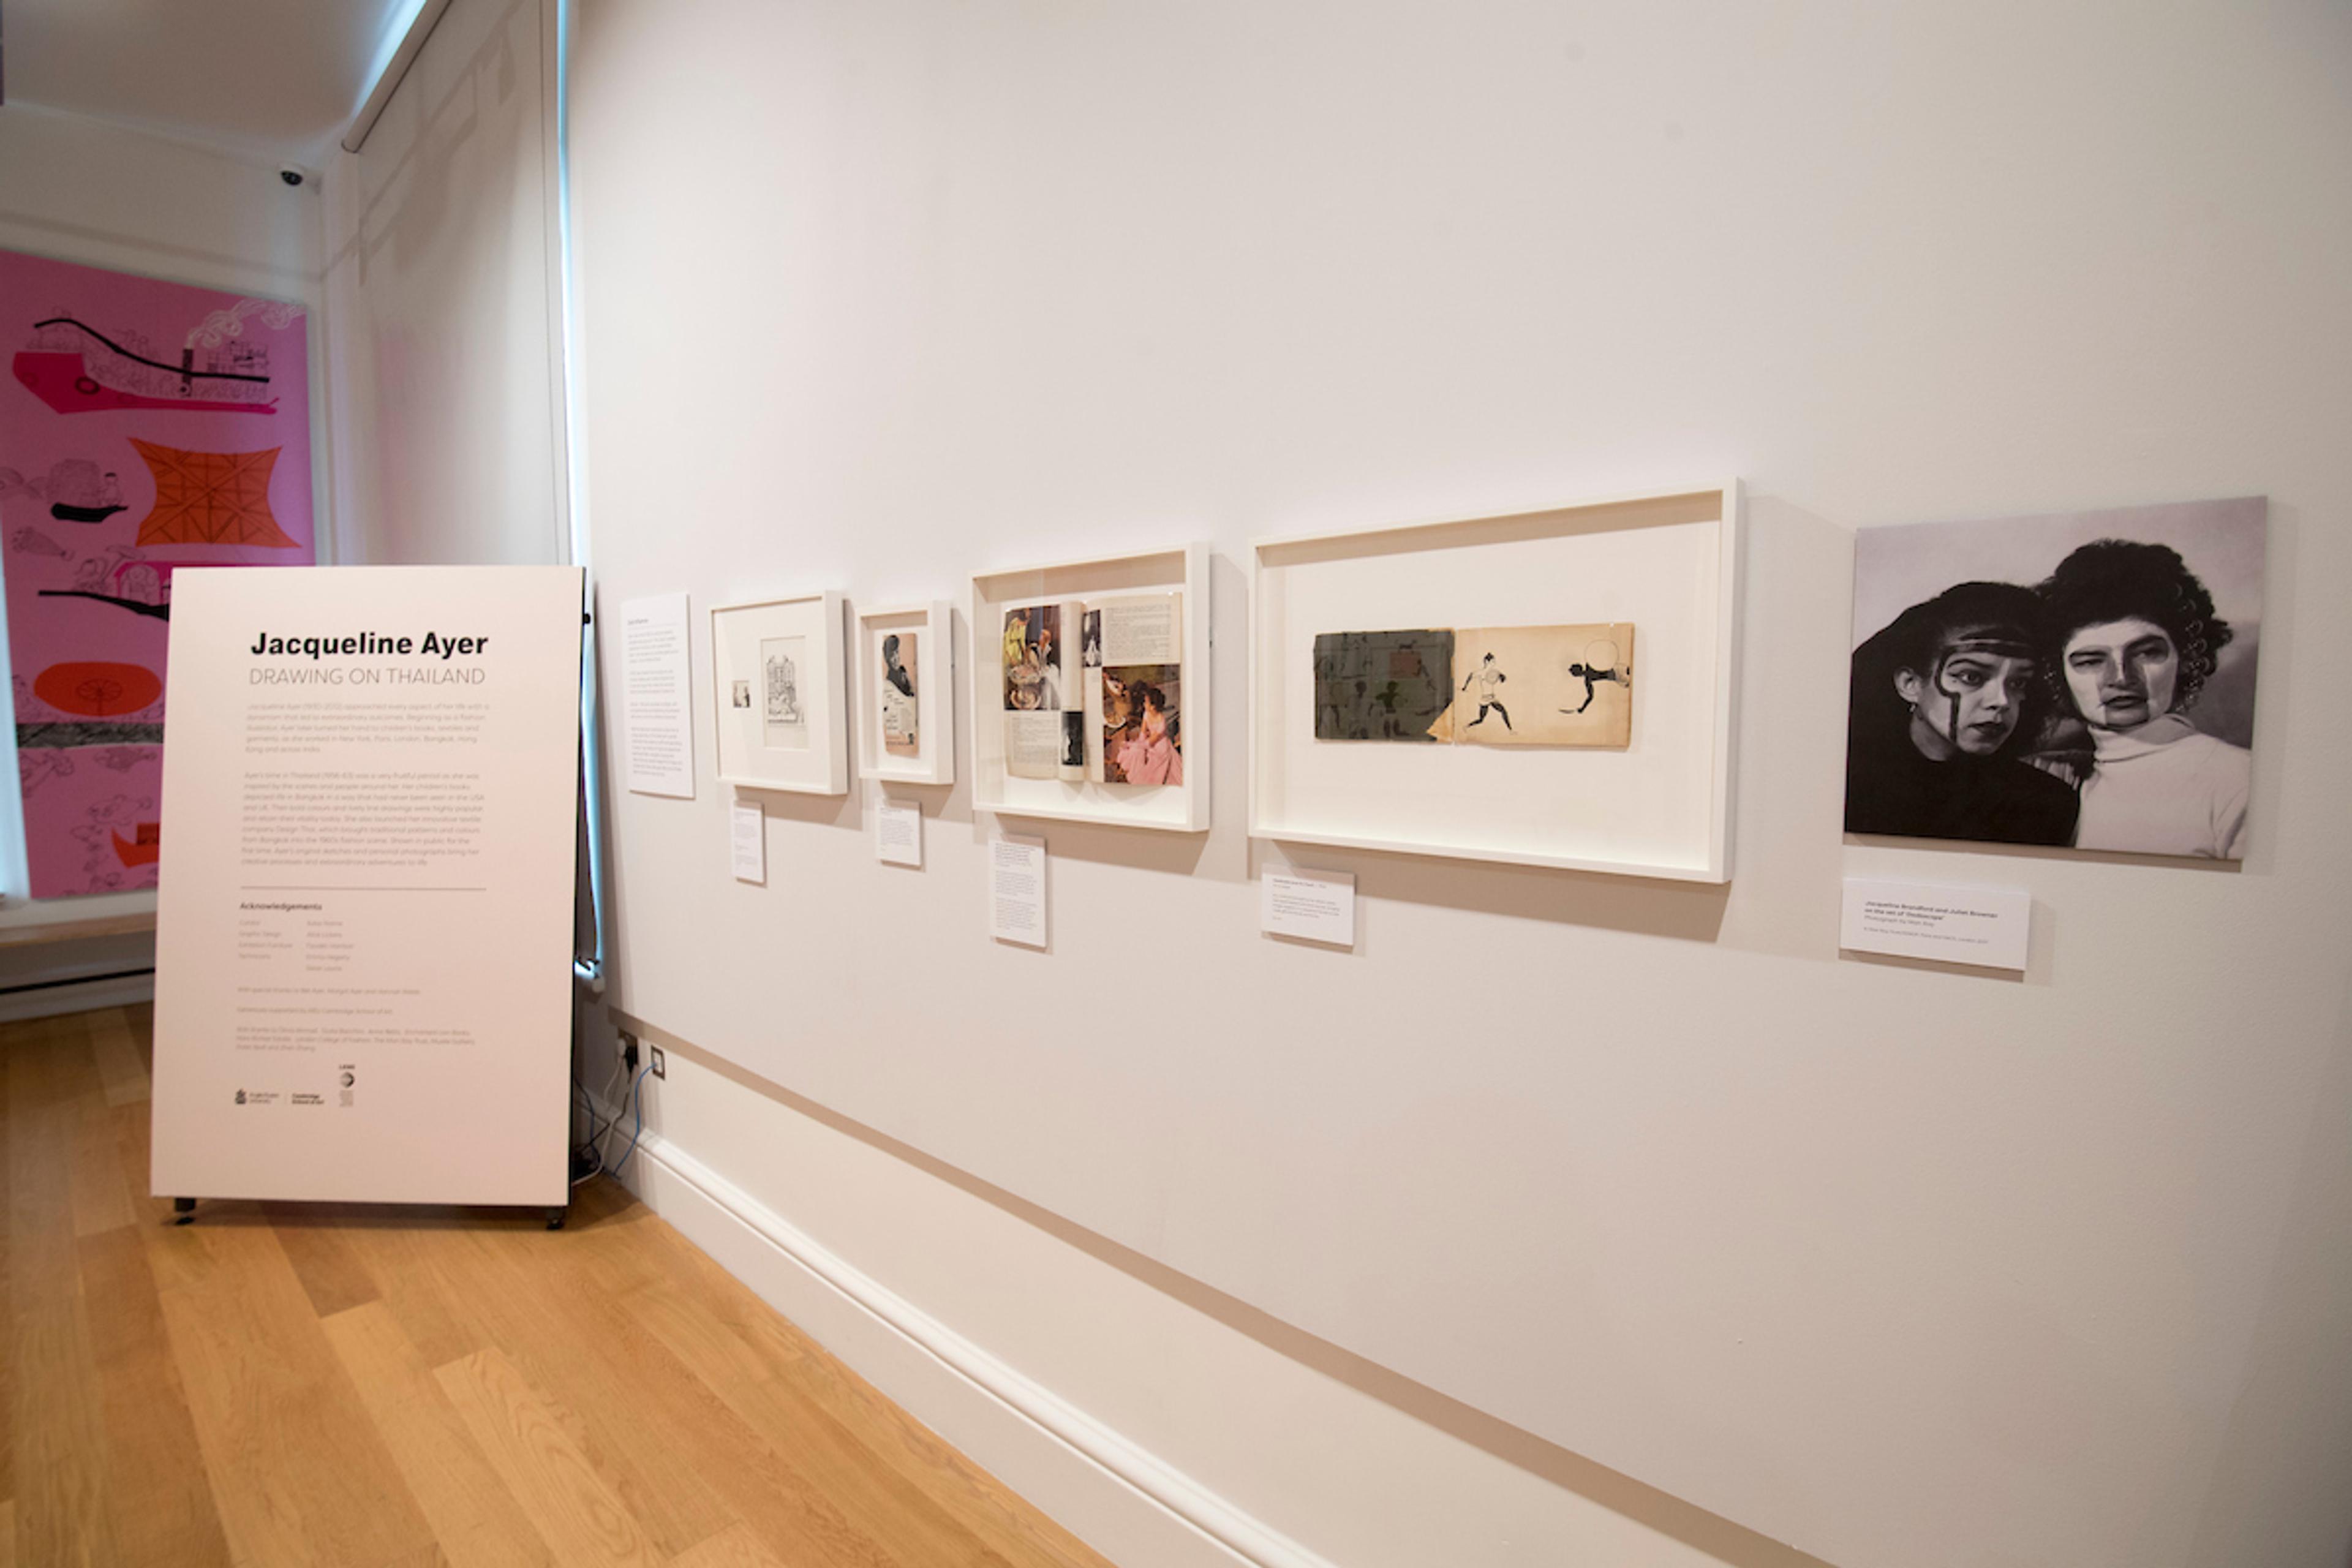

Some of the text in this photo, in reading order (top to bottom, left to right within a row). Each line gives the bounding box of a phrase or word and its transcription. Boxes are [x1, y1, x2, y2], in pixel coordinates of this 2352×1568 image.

[251, 631, 489, 660] Jacqueline Ayer
[249, 668, 486, 685] DRAWING ON THAILAND
[239, 902, 323, 913] Acknowledgements
